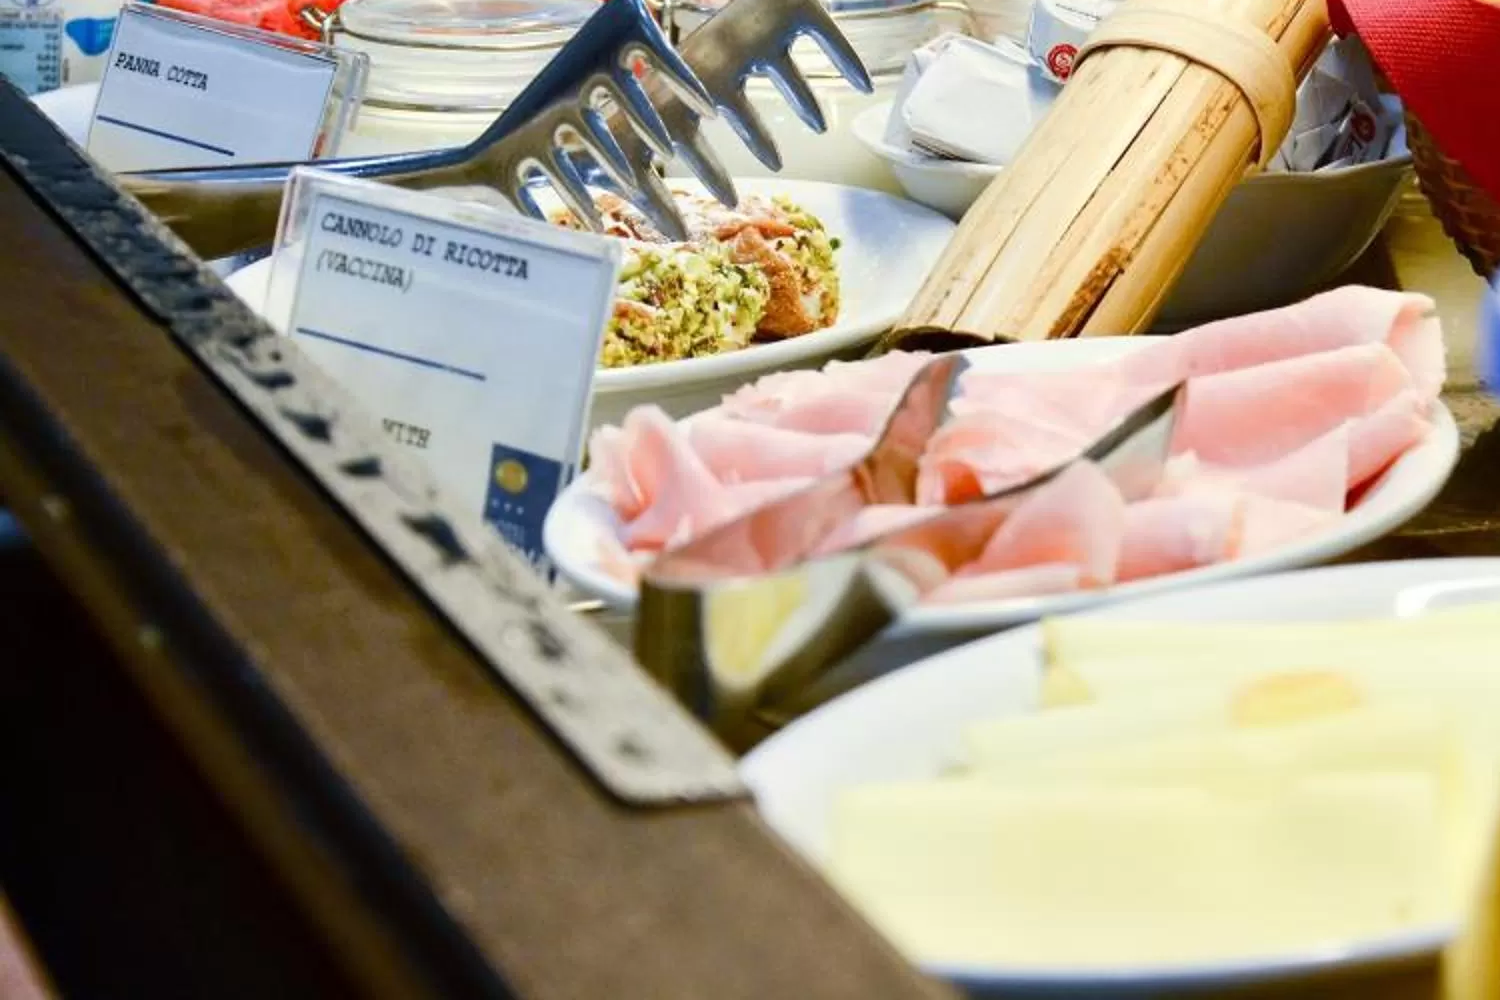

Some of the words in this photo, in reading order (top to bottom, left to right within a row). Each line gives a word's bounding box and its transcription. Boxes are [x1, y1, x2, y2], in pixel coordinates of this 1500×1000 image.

[114, 52, 160, 78] PANNA
[166, 64, 209, 91] COTTA
[320, 211, 403, 247] CANNOLO
[412, 233, 436, 256] DI
[444, 241, 529, 280] RICOTTA
[317, 249, 413, 293] (VACCINA)
